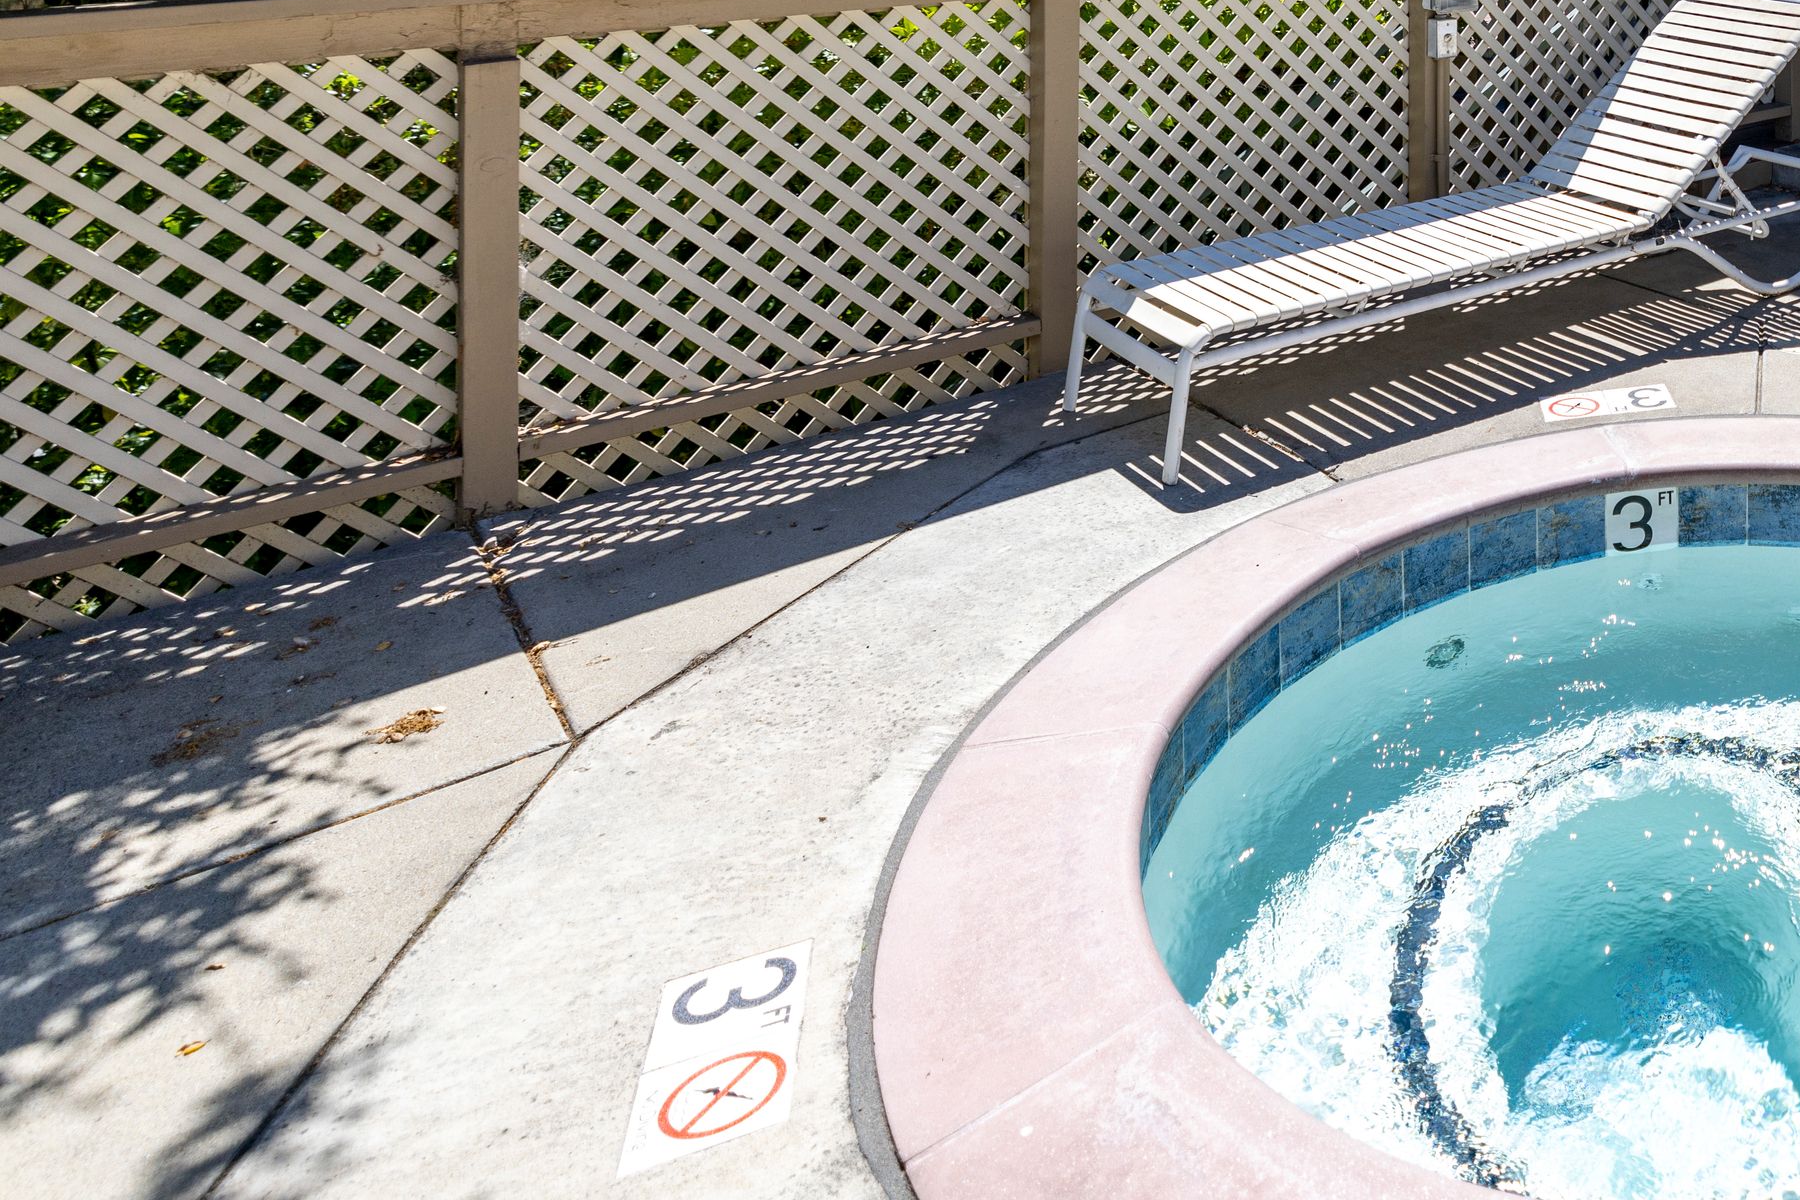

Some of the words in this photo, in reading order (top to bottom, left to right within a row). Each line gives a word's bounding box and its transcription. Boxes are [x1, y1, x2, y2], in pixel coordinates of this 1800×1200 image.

[1627, 387, 1667, 408] 3
[1612, 495, 1653, 552] 3
[1658, 490, 1675, 506] FT
[672, 957, 797, 1025] 3
[761, 1005, 791, 1028] FT
